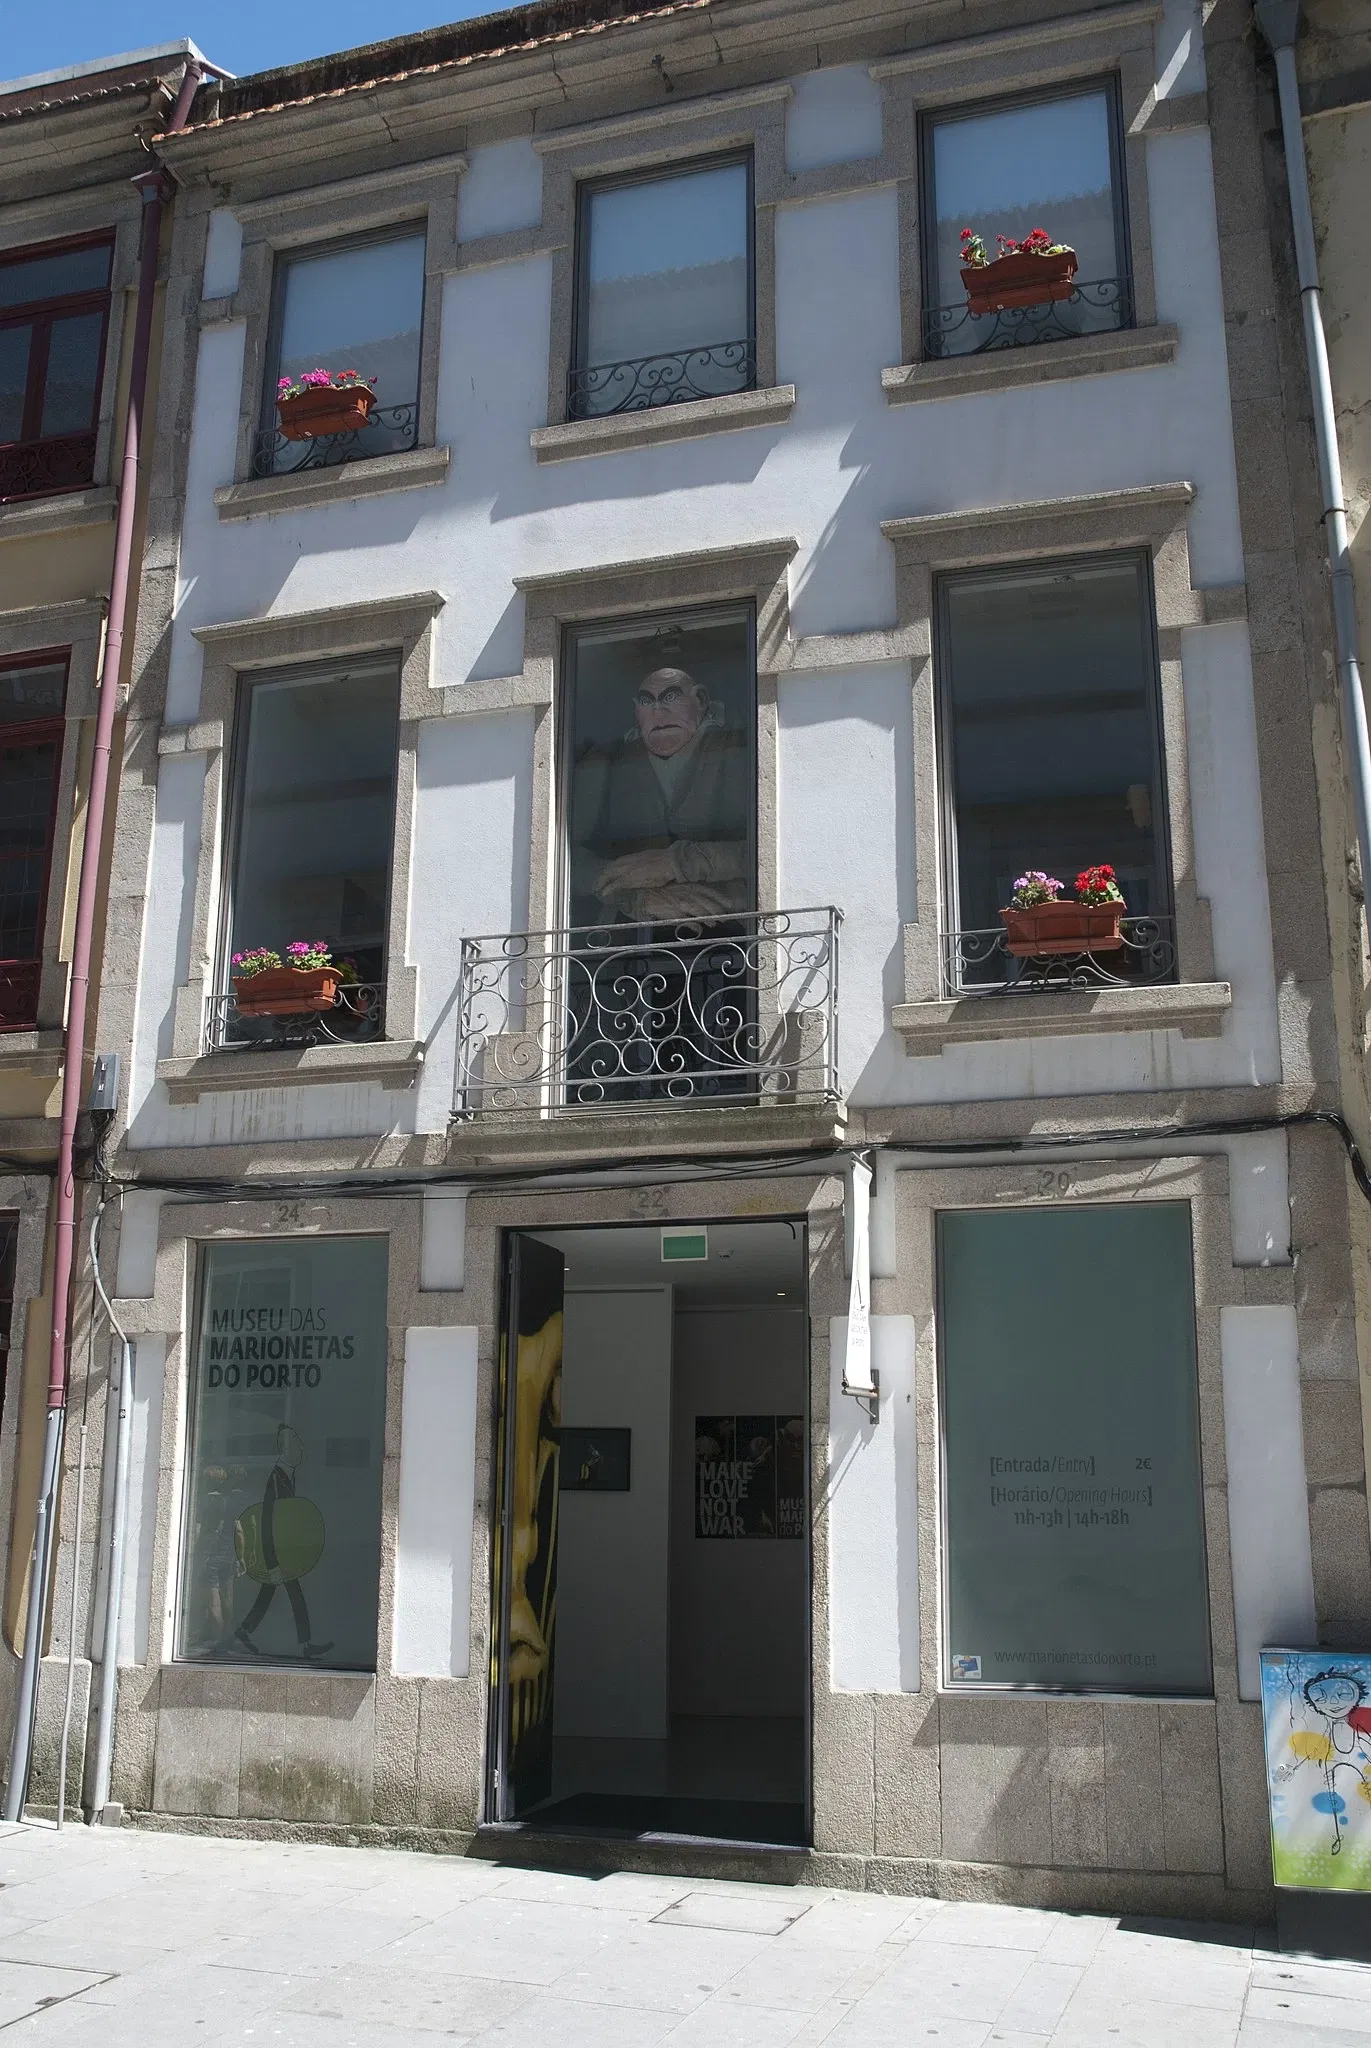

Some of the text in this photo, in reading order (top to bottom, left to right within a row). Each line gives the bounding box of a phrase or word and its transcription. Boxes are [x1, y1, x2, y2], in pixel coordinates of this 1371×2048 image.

[1038, 1170, 1069, 1196] 20
[638, 1191, 664, 1208] 22
[278, 1206, 300, 1223] 24
[212, 1308, 326, 1333] MUSEU DAS
[209, 1335, 355, 1360] MARIONETAS
[208, 1363, 322, 1389] DO PORTO
[700, 1461, 753, 1480] MAKE
[990, 1456, 1152, 1477] [Entrada/Entry] 2€
[700, 1480, 749, 1498] LOVE
[700, 1498, 739, 1516] NOT
[700, 1516, 746, 1535] WAR
[1014, 1508, 1063, 1528] 11h-13h
[1074, 1508, 1130, 1528] 14h-18h
[994, 1649, 1157, 1669] www.marionetasdoporto.pt
